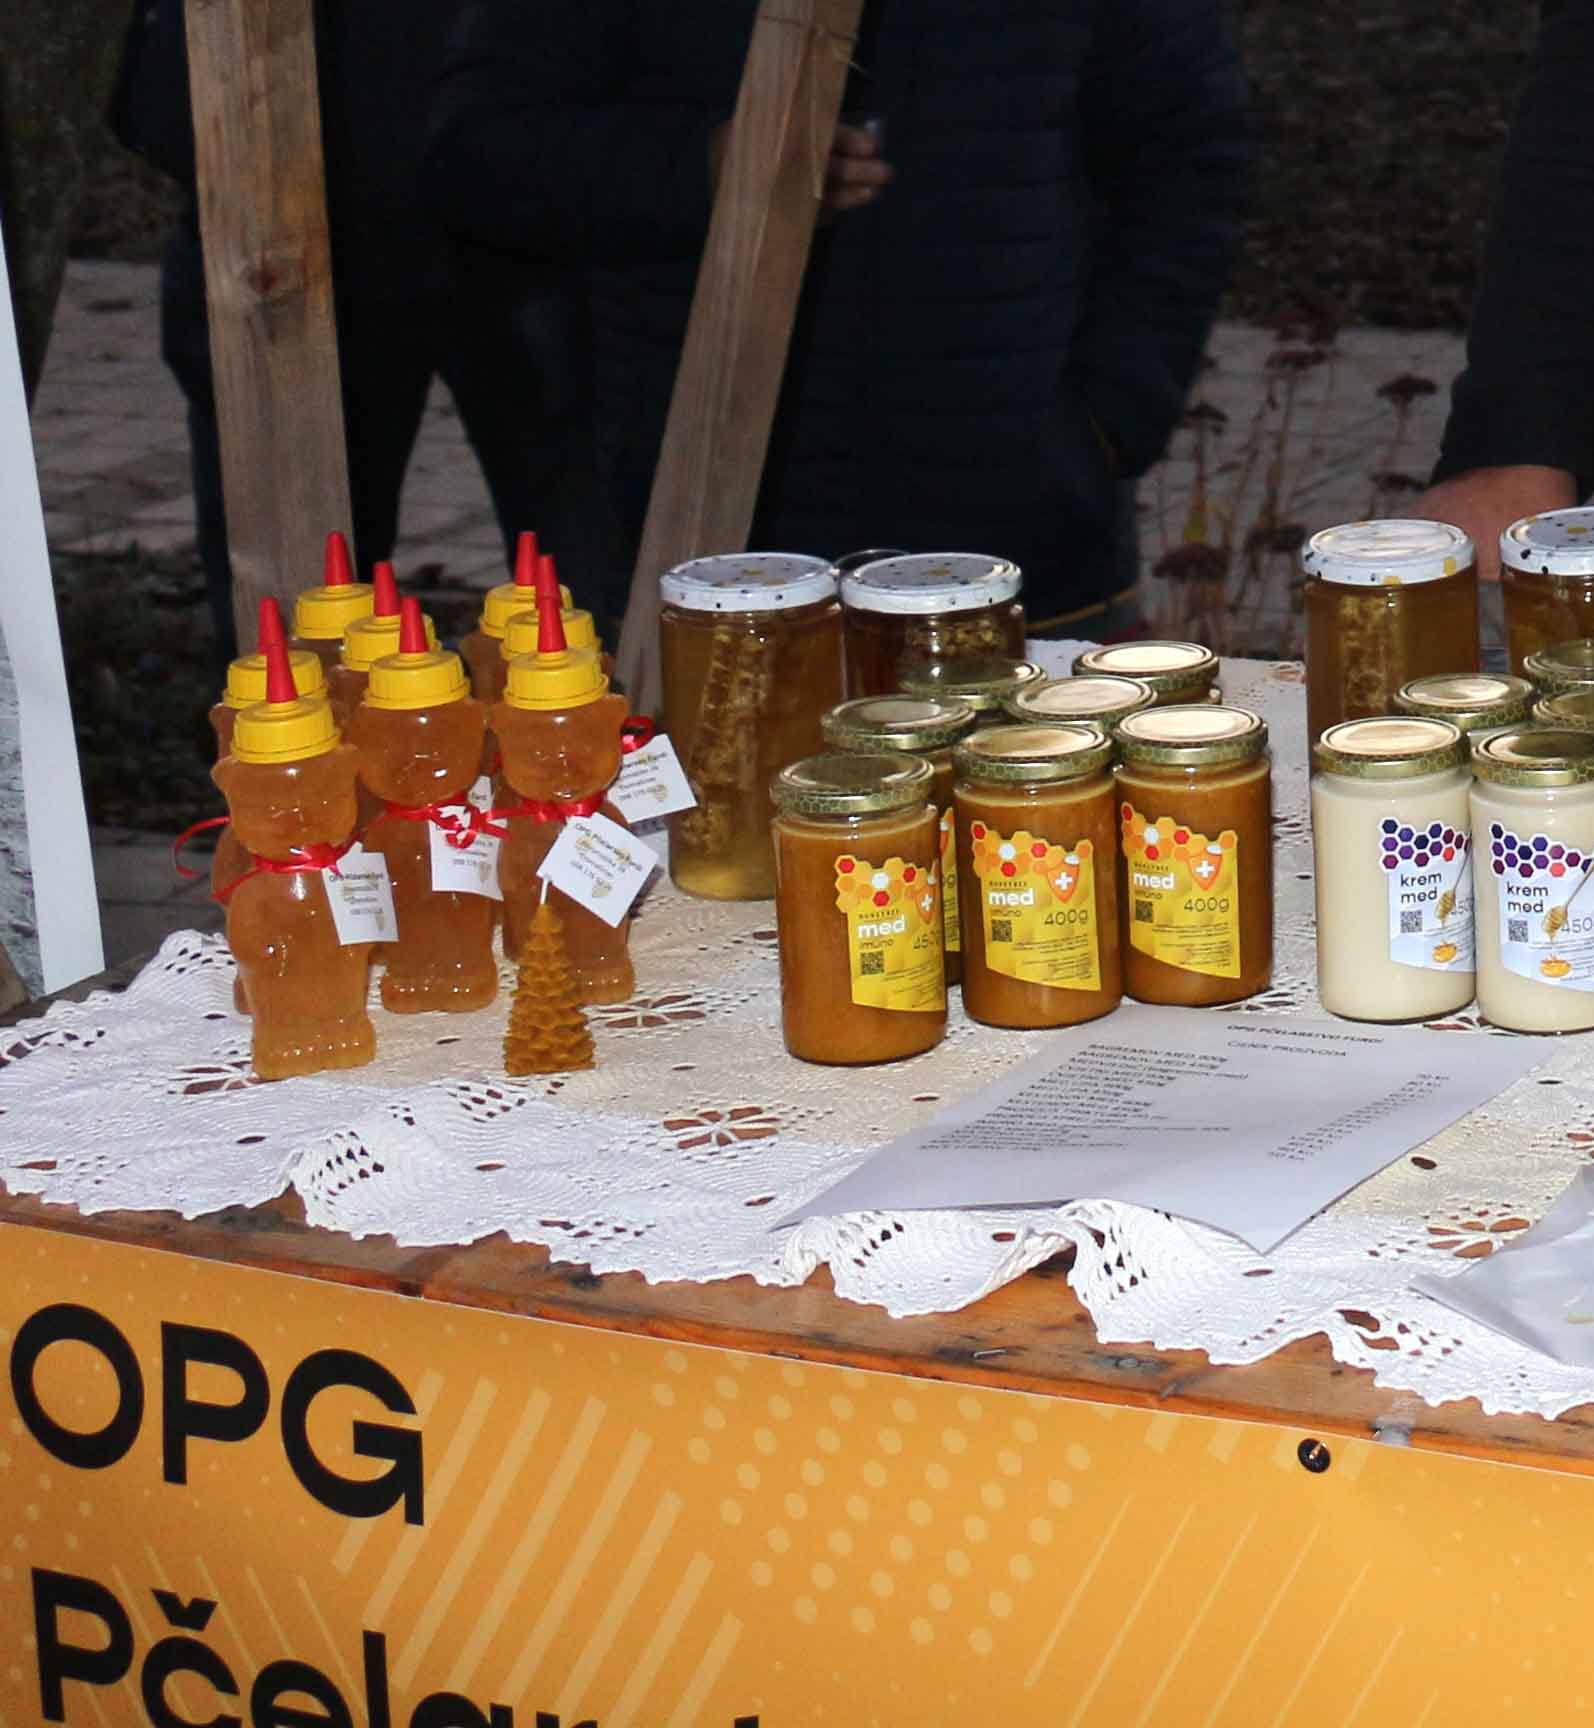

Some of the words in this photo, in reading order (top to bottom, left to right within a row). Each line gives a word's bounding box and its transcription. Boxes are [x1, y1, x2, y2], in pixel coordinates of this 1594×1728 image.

[1133, 872, 1175, 890] med
[1400, 871, 1442, 888] krem
[988, 888, 1035, 906] med
[1401, 888, 1438, 904] med
[1507, 881, 1549, 897] krem
[1183, 897, 1230, 913] 400g
[1508, 898, 1544, 913] med
[857, 914, 907, 939] med
[1044, 909, 1089, 927] 400g
[9, 1302, 425, 1526] OPG
